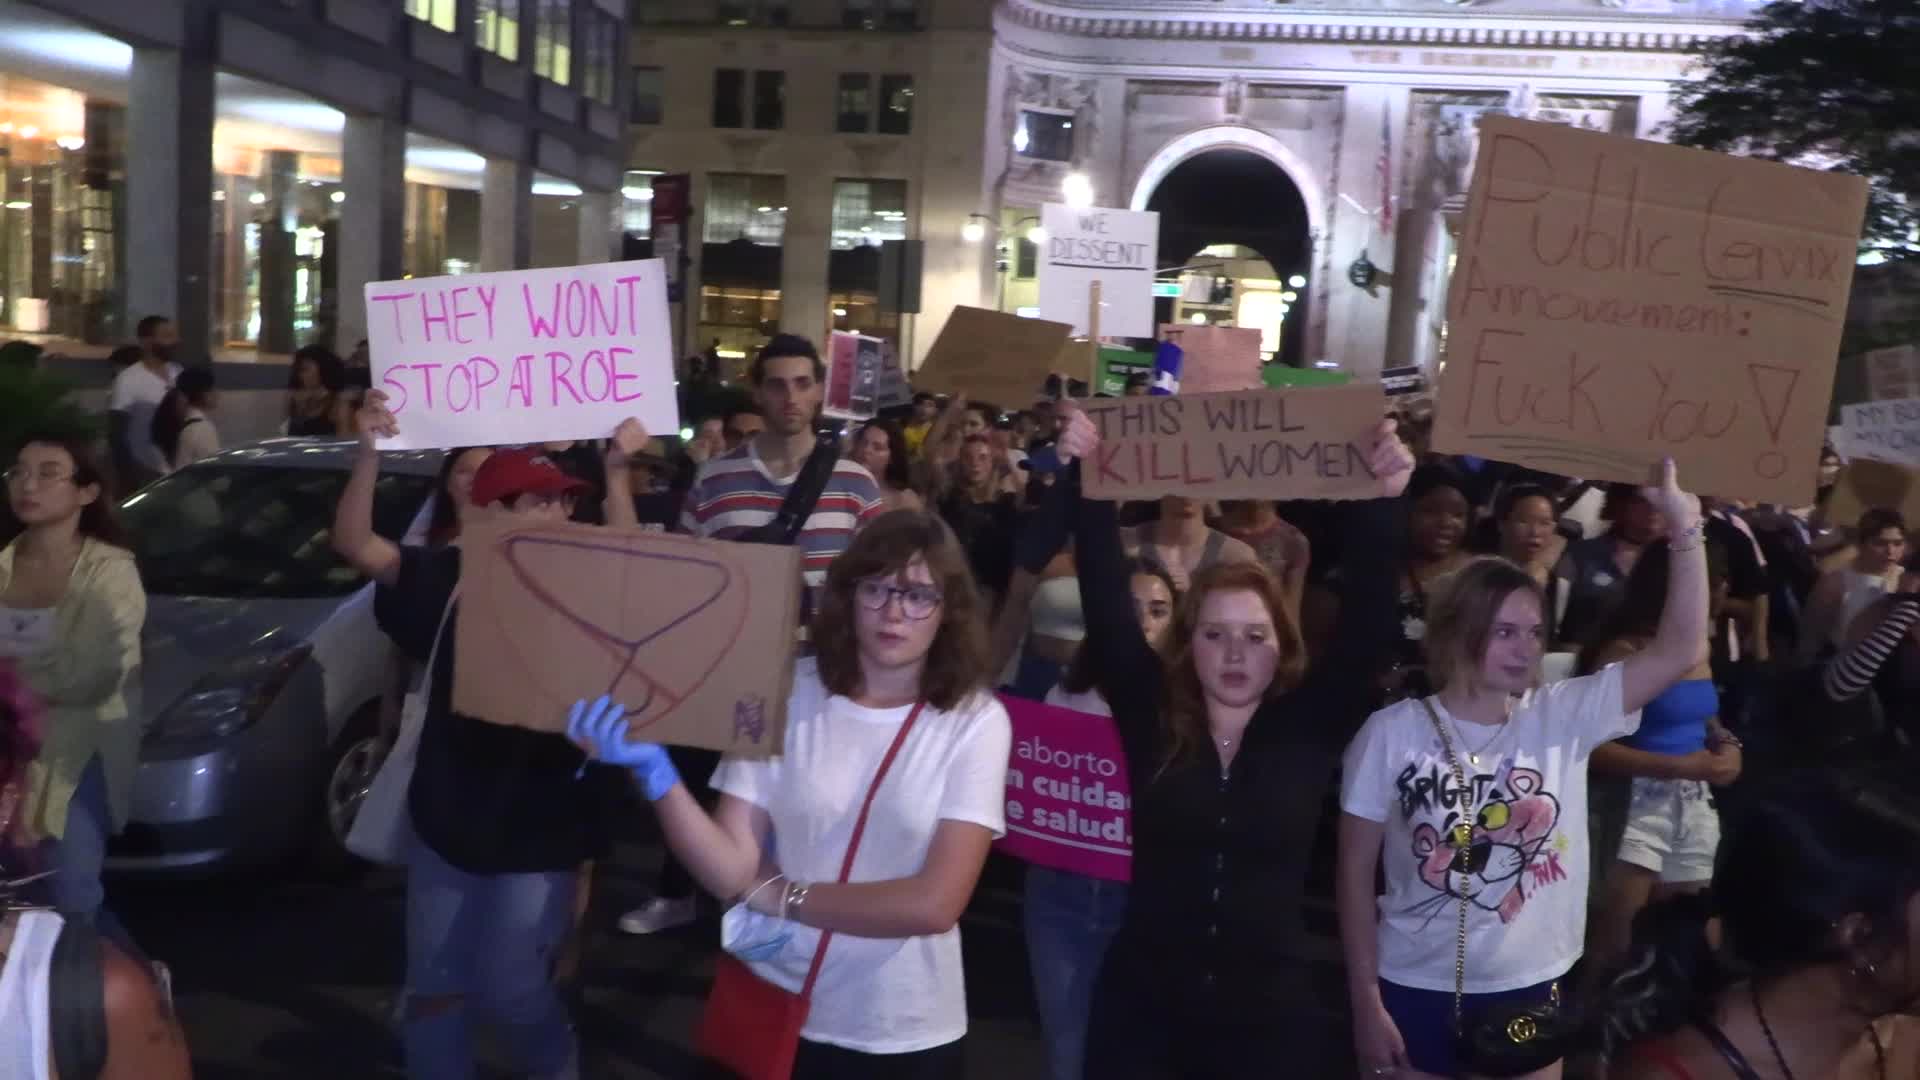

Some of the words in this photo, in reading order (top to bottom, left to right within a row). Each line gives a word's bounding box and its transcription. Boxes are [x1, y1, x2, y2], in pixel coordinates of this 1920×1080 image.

[1079, 212, 1110, 235] WE
[1048, 236, 1150, 265] DISSENT
[372, 285, 497, 345] THEY
[523, 275, 642, 339] WONT
[383, 356, 500, 413] STOP
[506, 354, 536, 408] AT
[544, 347, 642, 407] ROE
[1087, 398, 1184, 440] THIS
[1203, 399, 1306, 433] WILL
[1097, 440, 1214, 486] KILL
[1216, 440, 1378, 480] WOMEN
[1017, 735, 1118, 777] aborto
[1007, 767, 1025, 790] n
[1007, 799, 1025, 820] e
[1032, 807, 1133, 845] salud.
